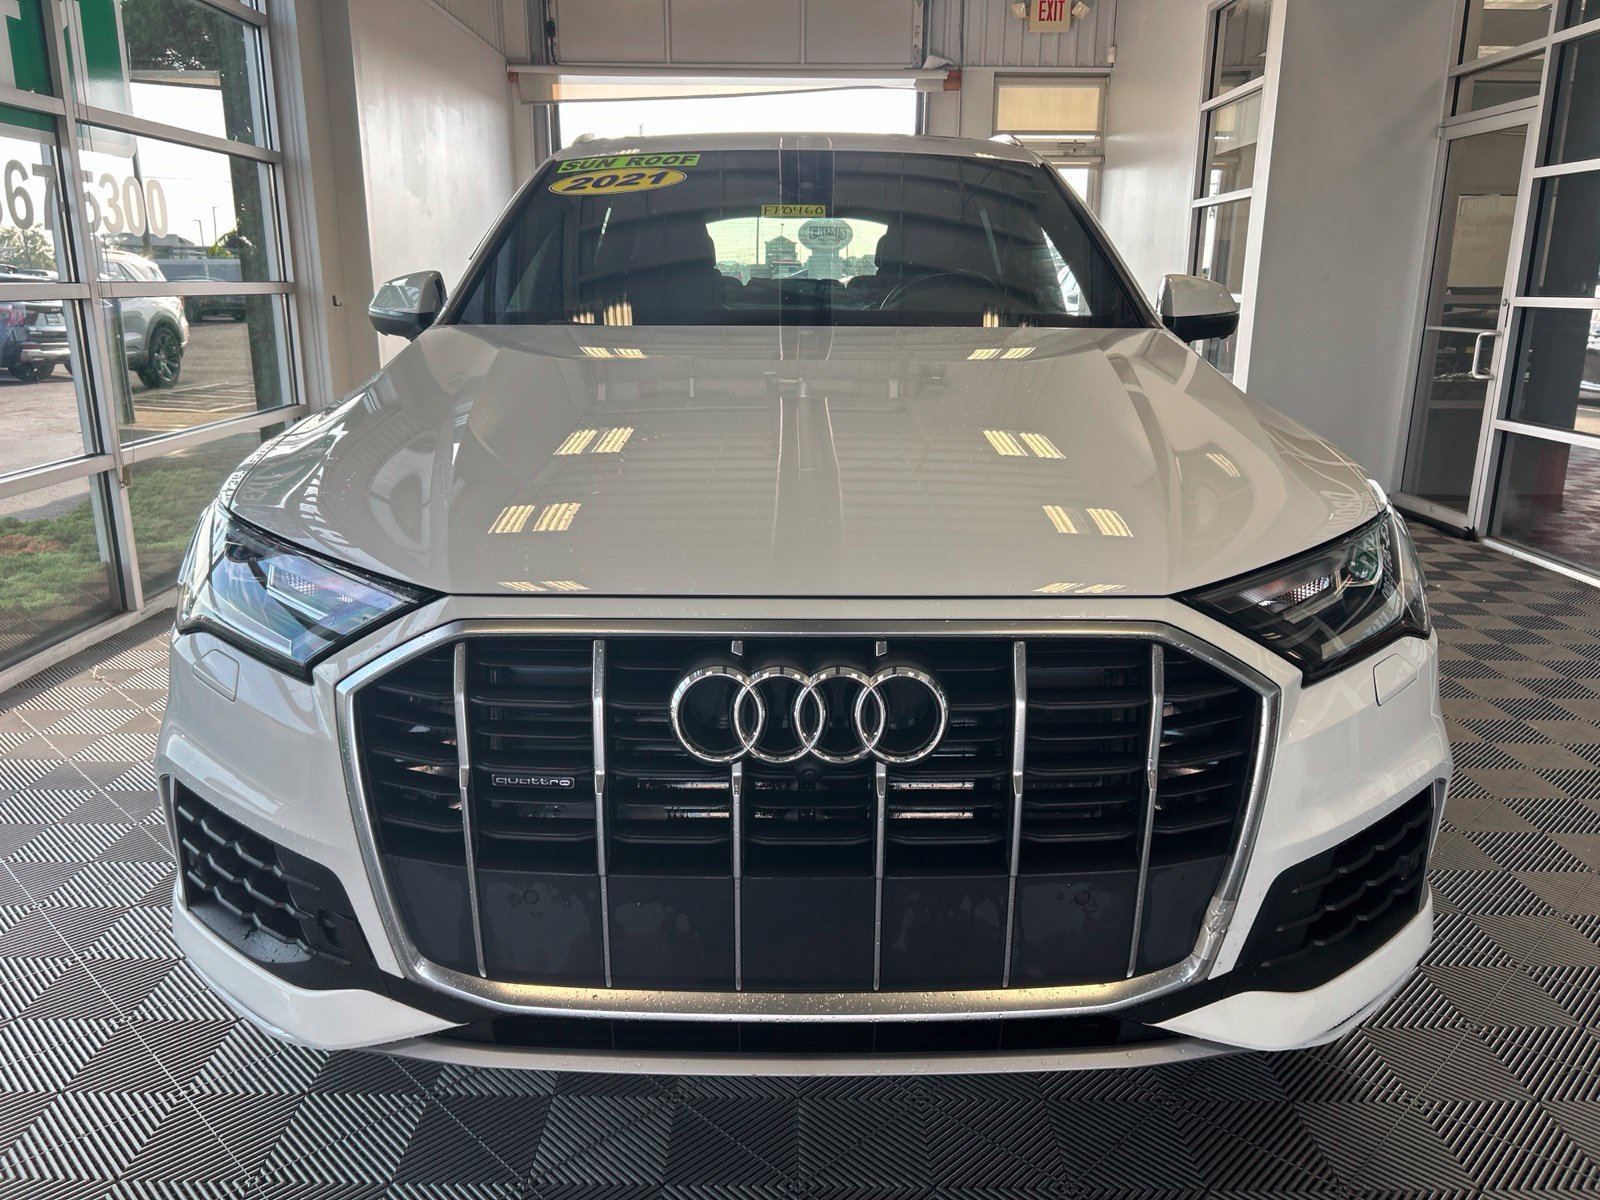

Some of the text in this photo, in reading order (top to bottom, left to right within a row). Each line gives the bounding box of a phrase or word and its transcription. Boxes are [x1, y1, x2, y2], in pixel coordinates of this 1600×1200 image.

[1039, 0, 1065, 21] EXIT
[562, 154, 696, 171] SUN ROOF
[562, 171, 669, 191] 2021
[495, 777, 571, 786] quattro
